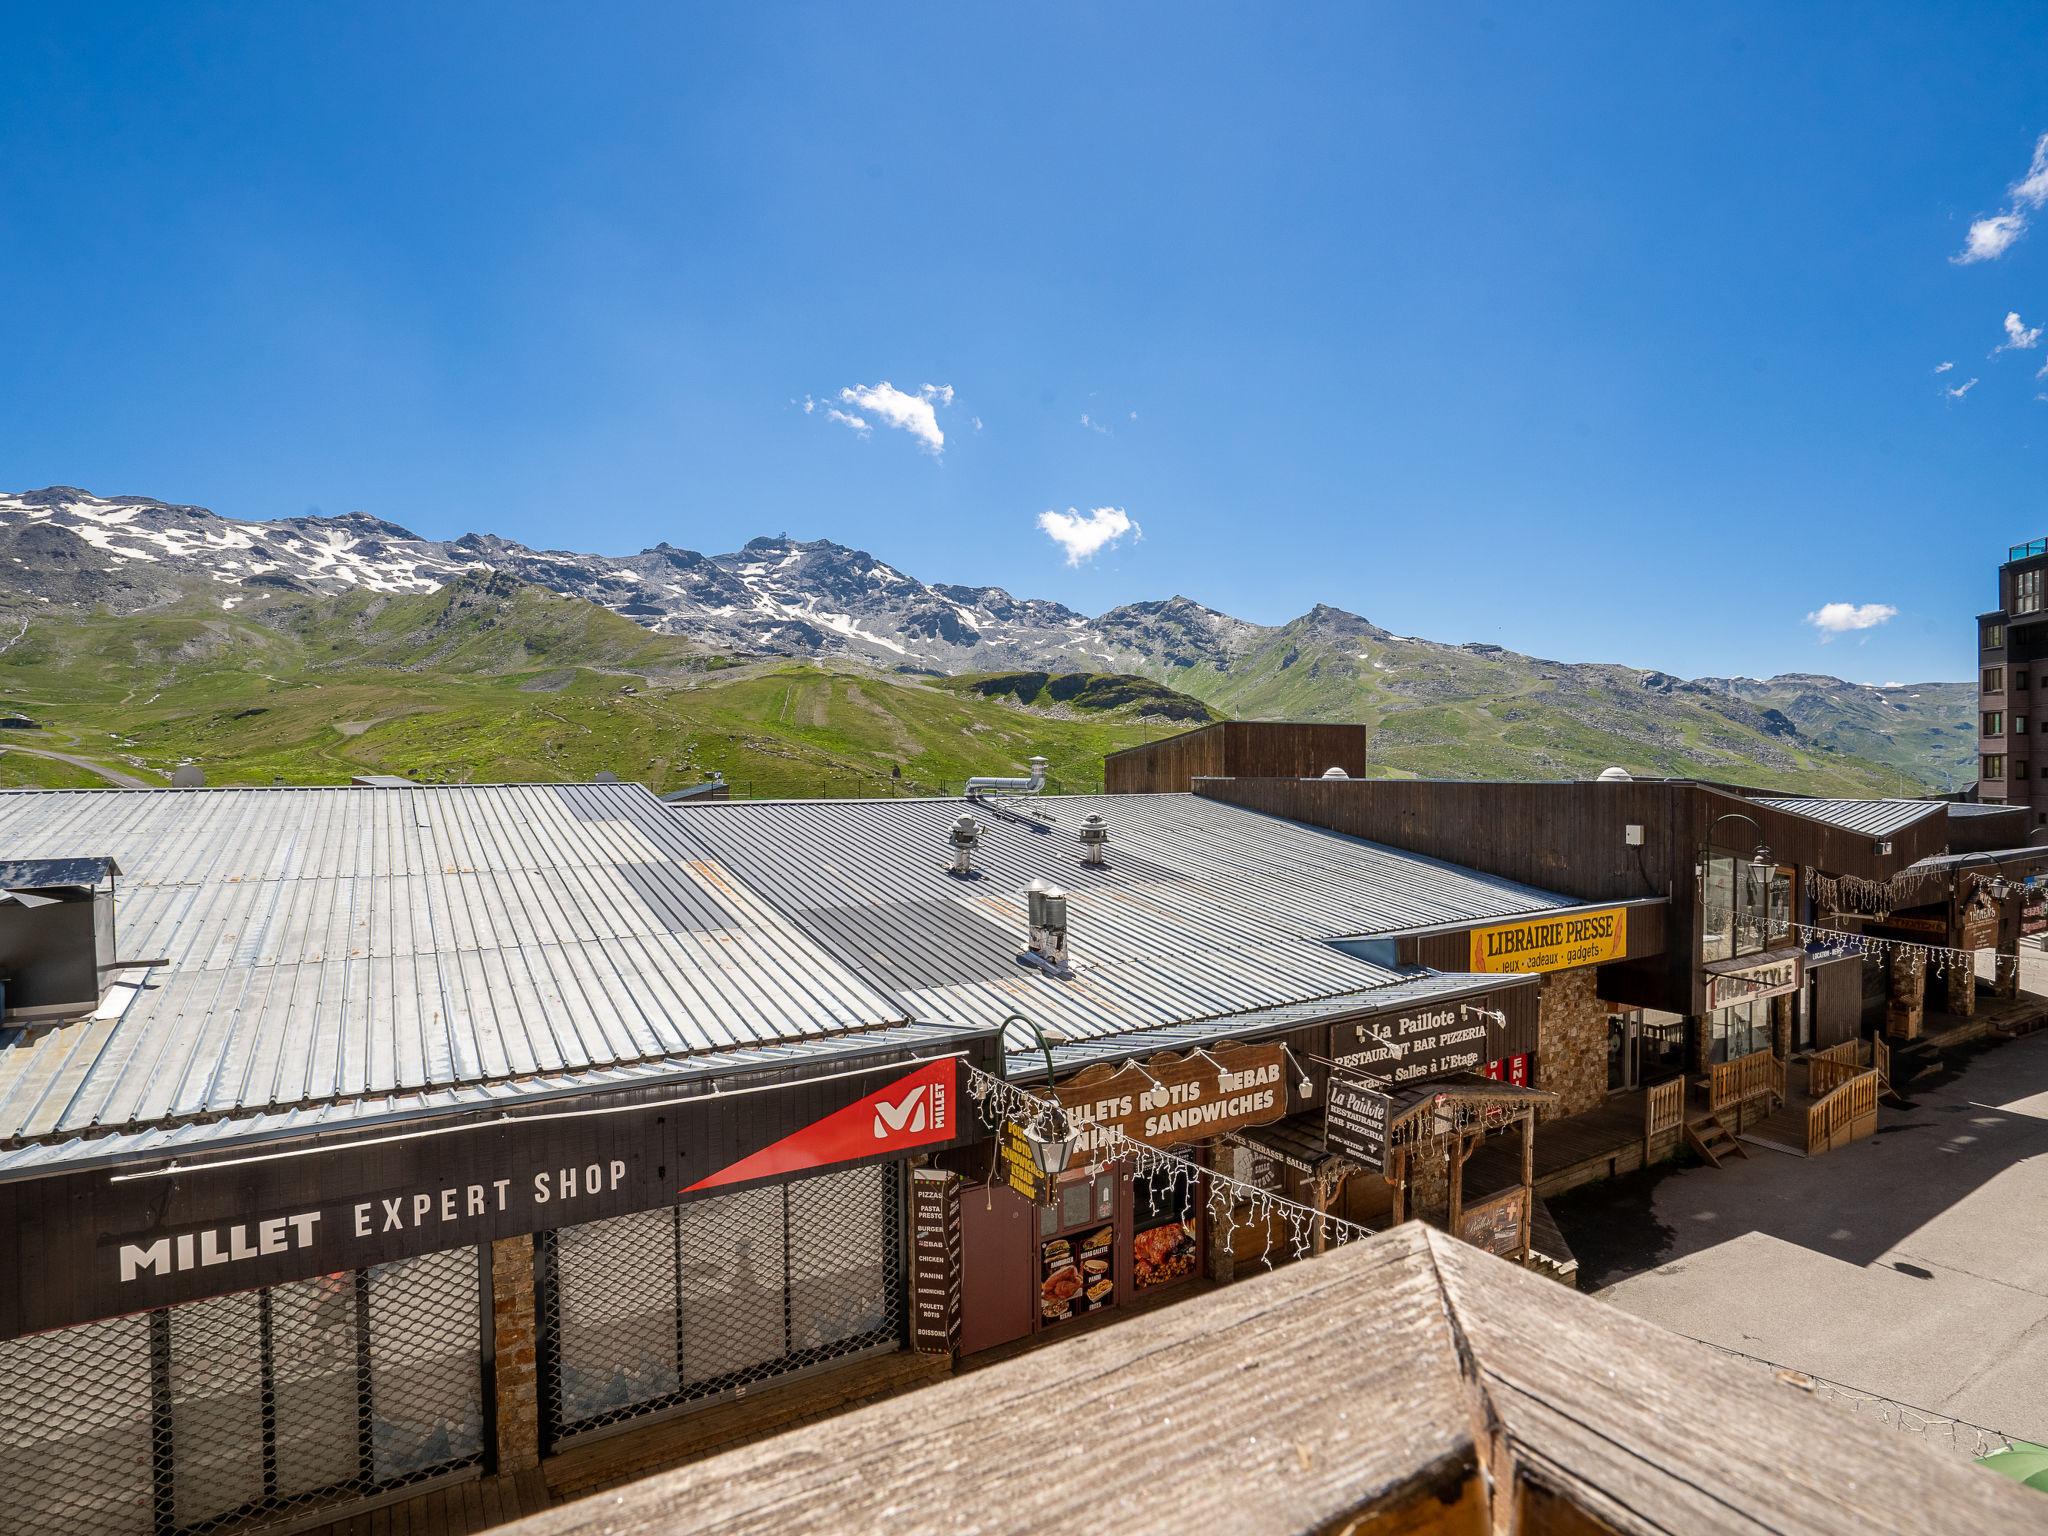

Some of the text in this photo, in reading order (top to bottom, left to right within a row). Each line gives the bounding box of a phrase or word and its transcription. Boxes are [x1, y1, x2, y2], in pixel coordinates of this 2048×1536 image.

[1487, 915, 1614, 957] LIBRAIRIE PRESSE
[1526, 952, 1559, 969] cadeaux
[1566, 942, 1600, 965] gadgets
[1812, 950, 1830, 961] LOCATION
[1372, 1010, 1455, 1042] La Paillote
[1412, 1036, 1437, 1053] BAR
[1439, 1025, 1487, 1047] PIZZERIA
[1394, 1064, 1428, 1082] Salles
[1430, 1058, 1438, 1073] à
[1440, 1052, 1479, 1071] L'Etage
[934, 1083, 945, 1129] MILLET
[1330, 1086, 1346, 1107] La
[1066, 1095, 1134, 1128] ULETS
[1072, 1089, 1274, 1154] NINI SANDWICHES
[1330, 1104, 1384, 1131] RESTAURANT
[1327, 1114, 1384, 1142] BAR PIZZERIA
[1247, 1140, 1284, 1163] TERRASSE
[1285, 1156, 1313, 1174] SALLES
[917, 1191, 943, 1199] PIZZAS
[120, 1160, 626, 1283] MILLET EXPERT SHOP
[917, 1225, 944, 1233] BURGER
[918, 1211, 943, 1220] PRESTO
[918, 1255, 944, 1263] CHICKEN
[919, 1272, 944, 1280] PANINI
[919, 1302, 944, 1311] POULETS
[917, 1328, 946, 1338] BOISSONS
